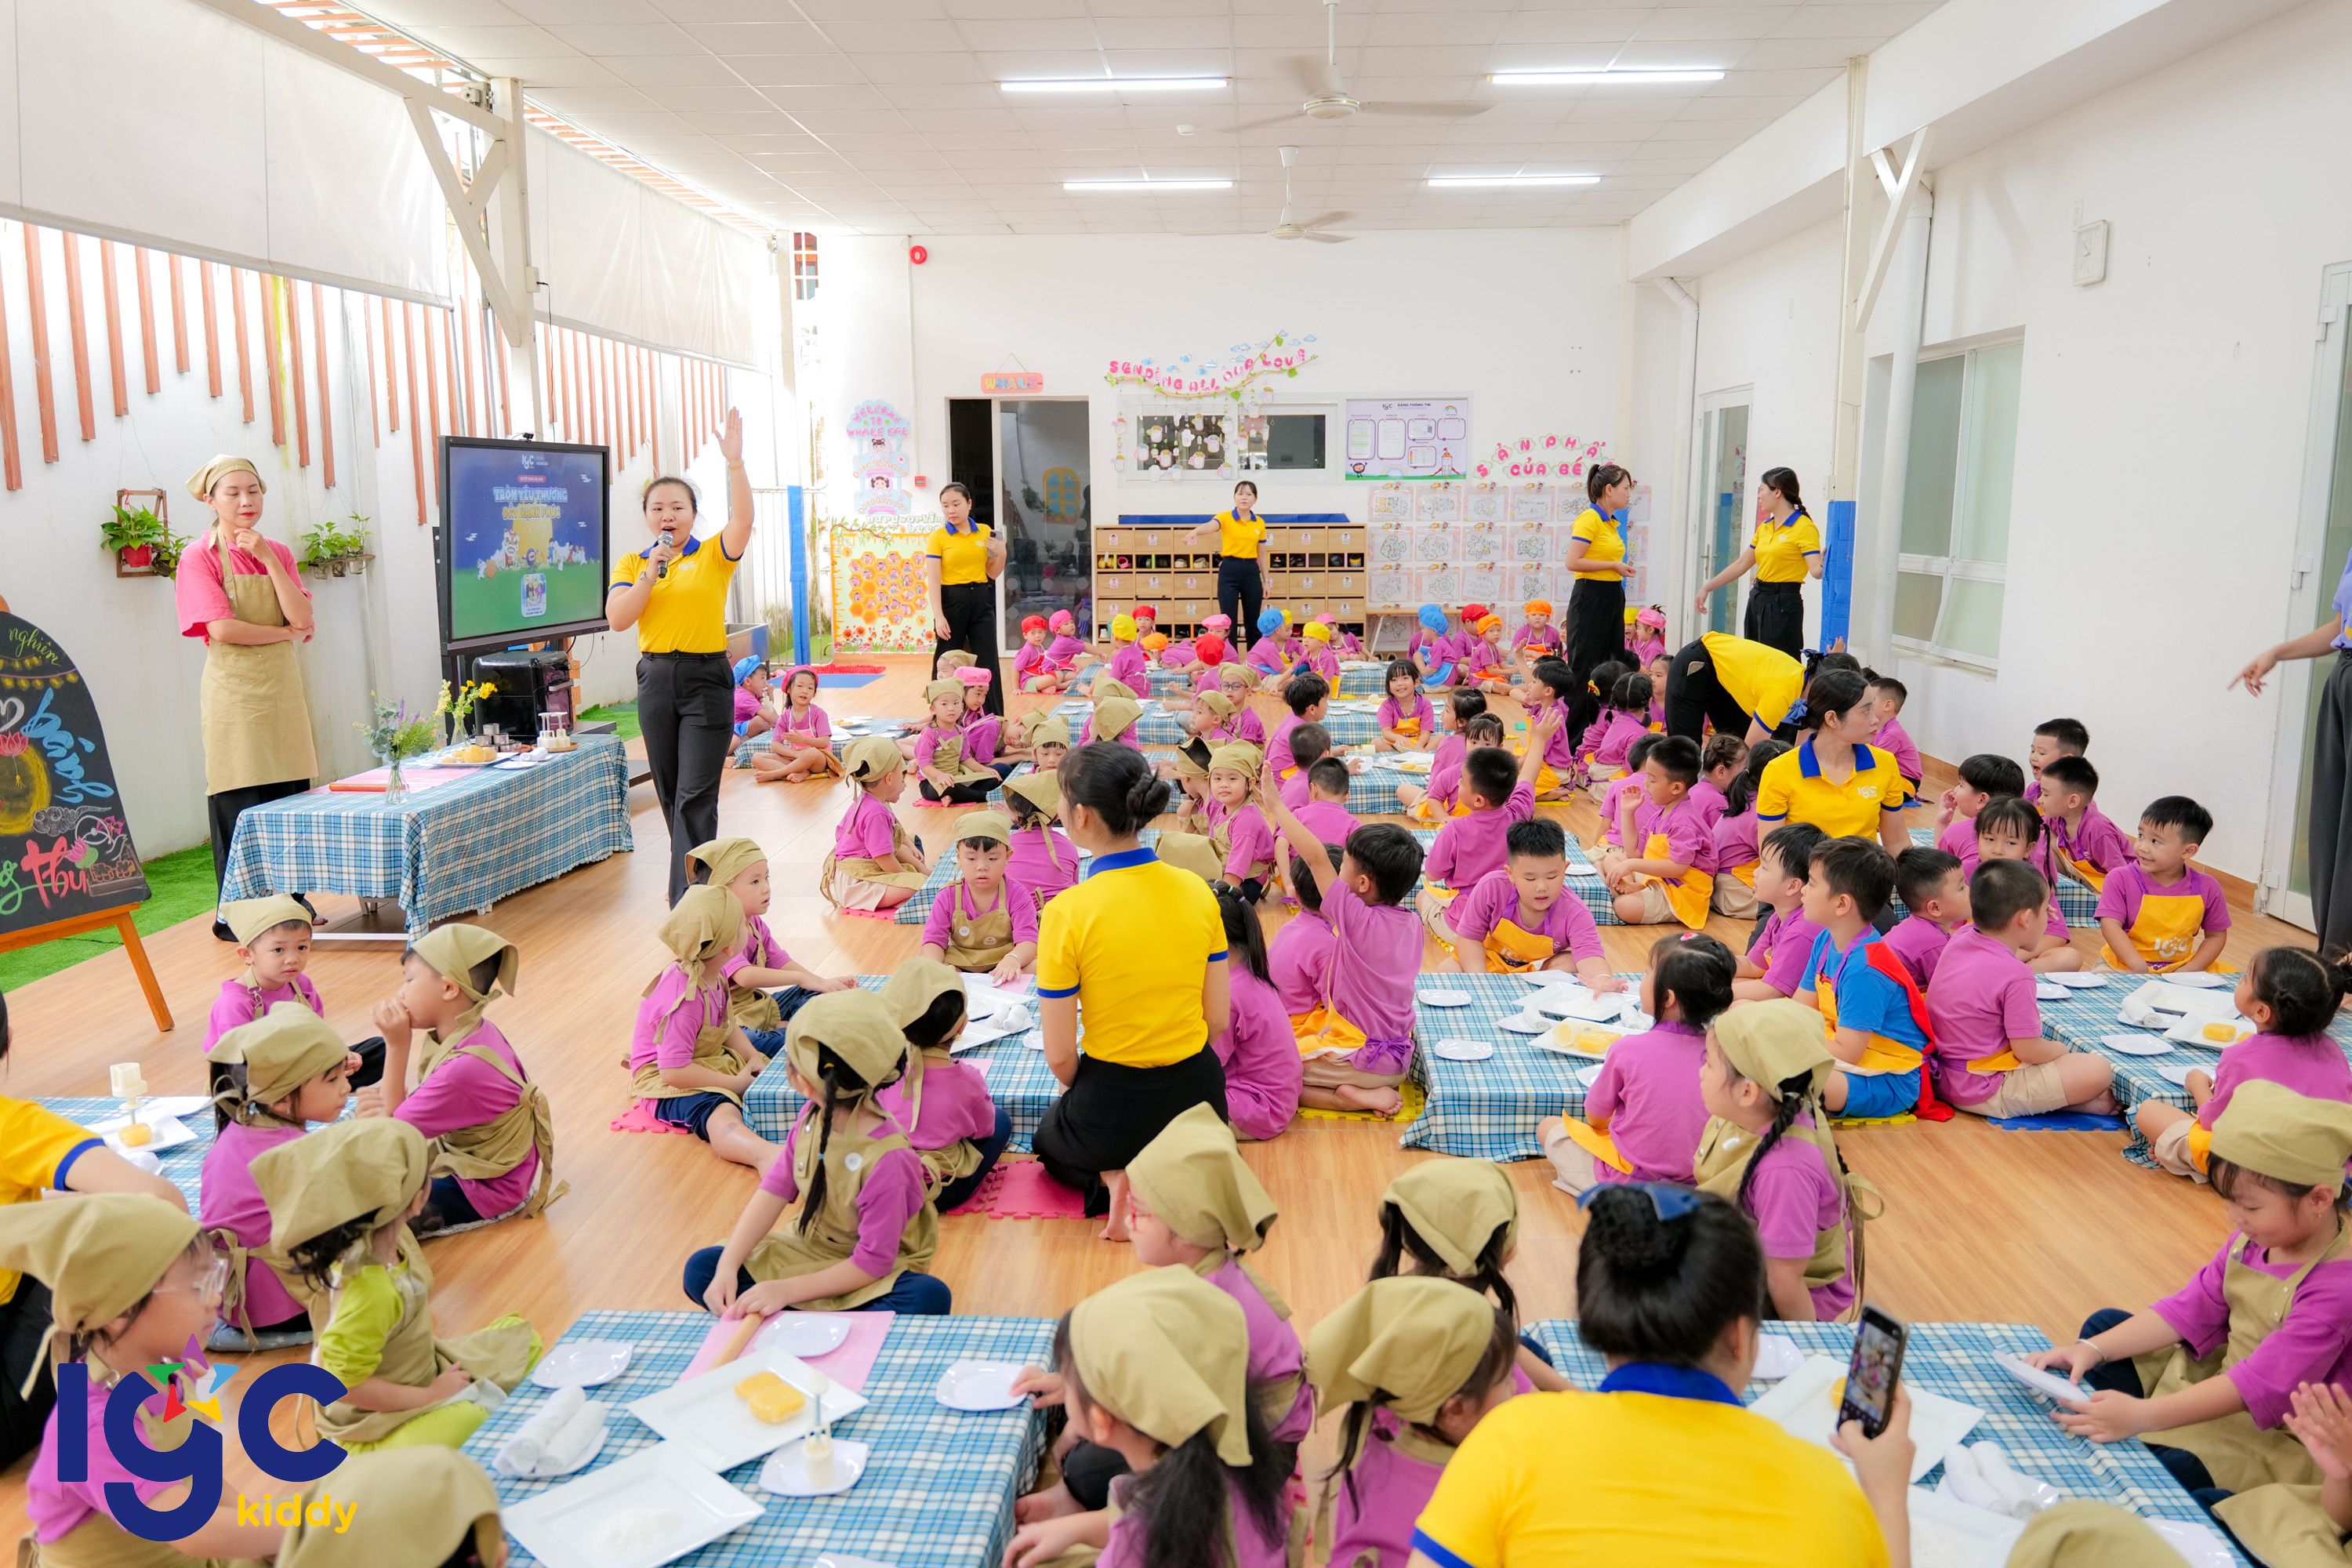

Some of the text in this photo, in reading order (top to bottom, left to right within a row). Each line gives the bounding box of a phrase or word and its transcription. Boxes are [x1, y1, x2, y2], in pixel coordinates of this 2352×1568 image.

[1189, 378, 1220, 392] ALL
[1223, 358, 1254, 382] OUR
[1261, 348, 1305, 368] LOVE
[984, 376, 1038, 390] WHALE
[853, 405, 902, 422] WELCOME
[871, 416, 882, 426] TO
[1545, 435, 1613, 466] PHẨ
[1510, 456, 1582, 476] CỦA BÉ
[518, 485, 534, 503] YÊU
